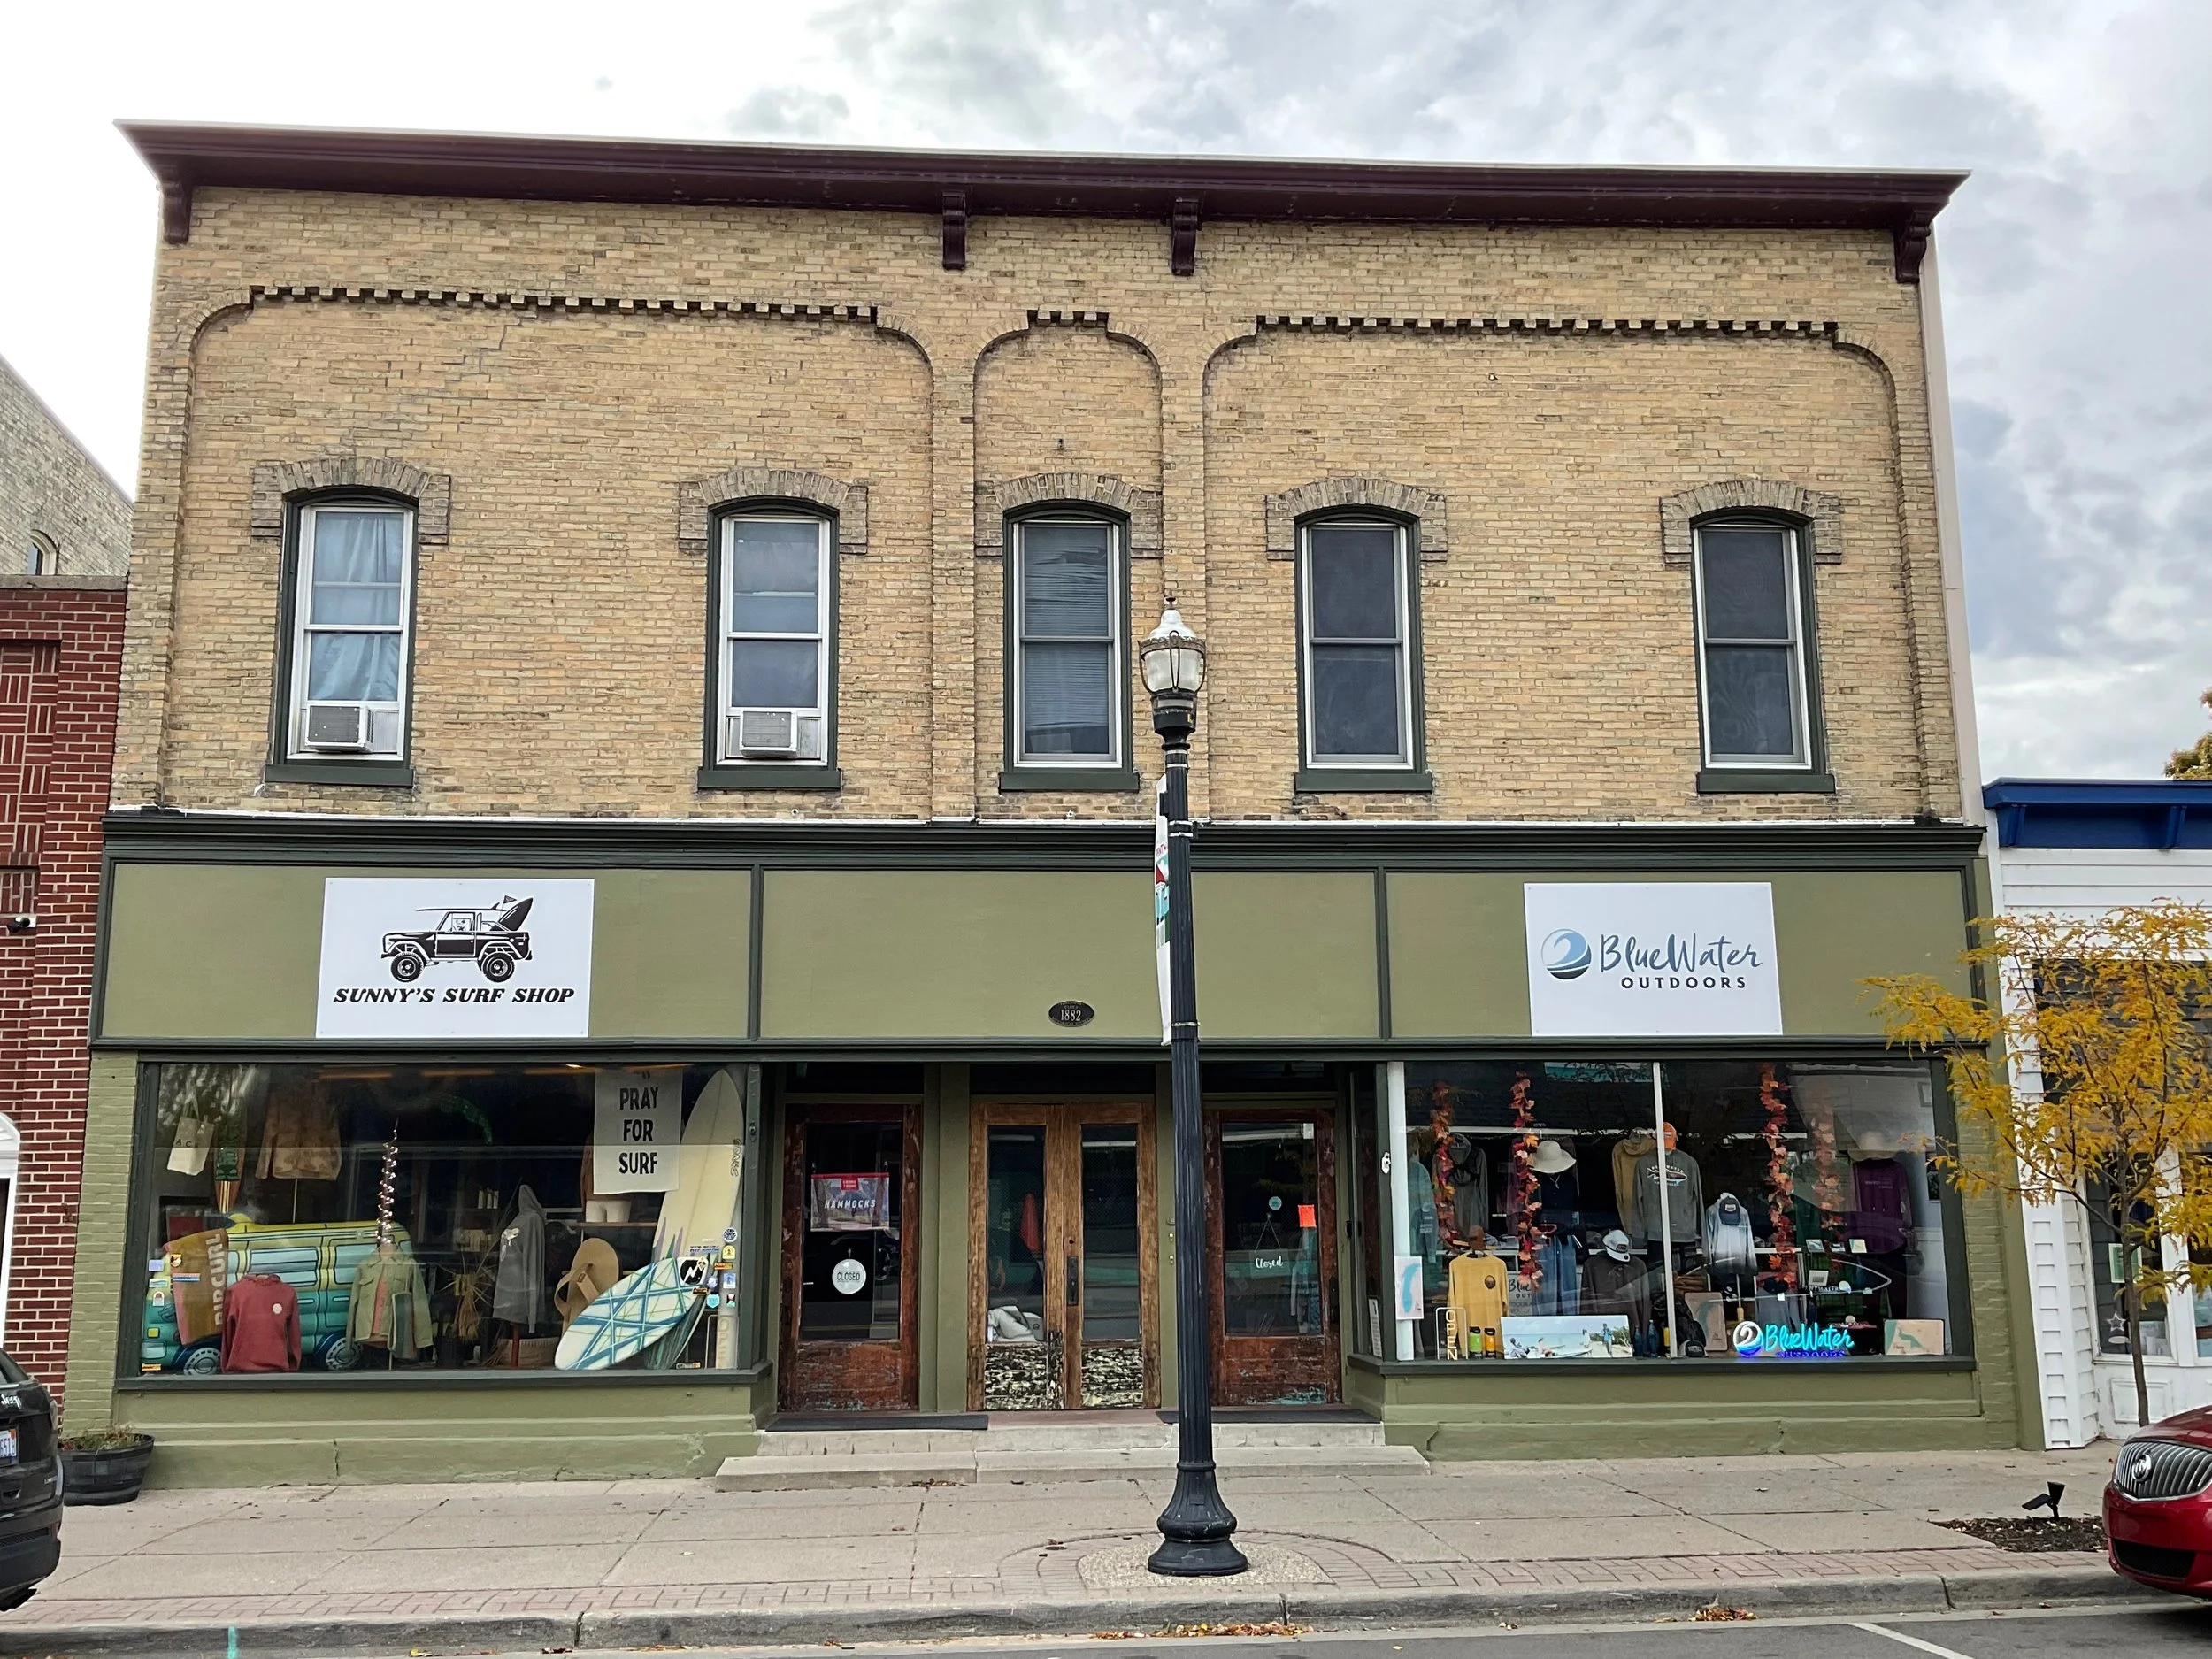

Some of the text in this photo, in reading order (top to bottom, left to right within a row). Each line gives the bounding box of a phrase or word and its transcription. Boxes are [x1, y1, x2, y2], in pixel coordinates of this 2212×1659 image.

[1600, 933, 1763, 973] BlueWater
[1621, 977, 1746, 988] OUTDOORS
[334, 988, 575, 1003] SUNNY'S SURF SHOP
[1061, 1010, 1081, 1021] 1882
[619, 1087, 659, 1110] PRAY
[623, 1119, 654, 1141] FOR
[618, 1152, 658, 1175] SURF
[825, 1200, 876, 1209] HAMMOCKS
[1255, 1256, 1284, 1269] Closed
[836, 1271, 861, 1282] CLOSED
[1445, 1310, 1459, 1360] OPEN
[1764, 1322, 1855, 1352] BlueWater
[1, 1394, 21, 1409] Jeep
